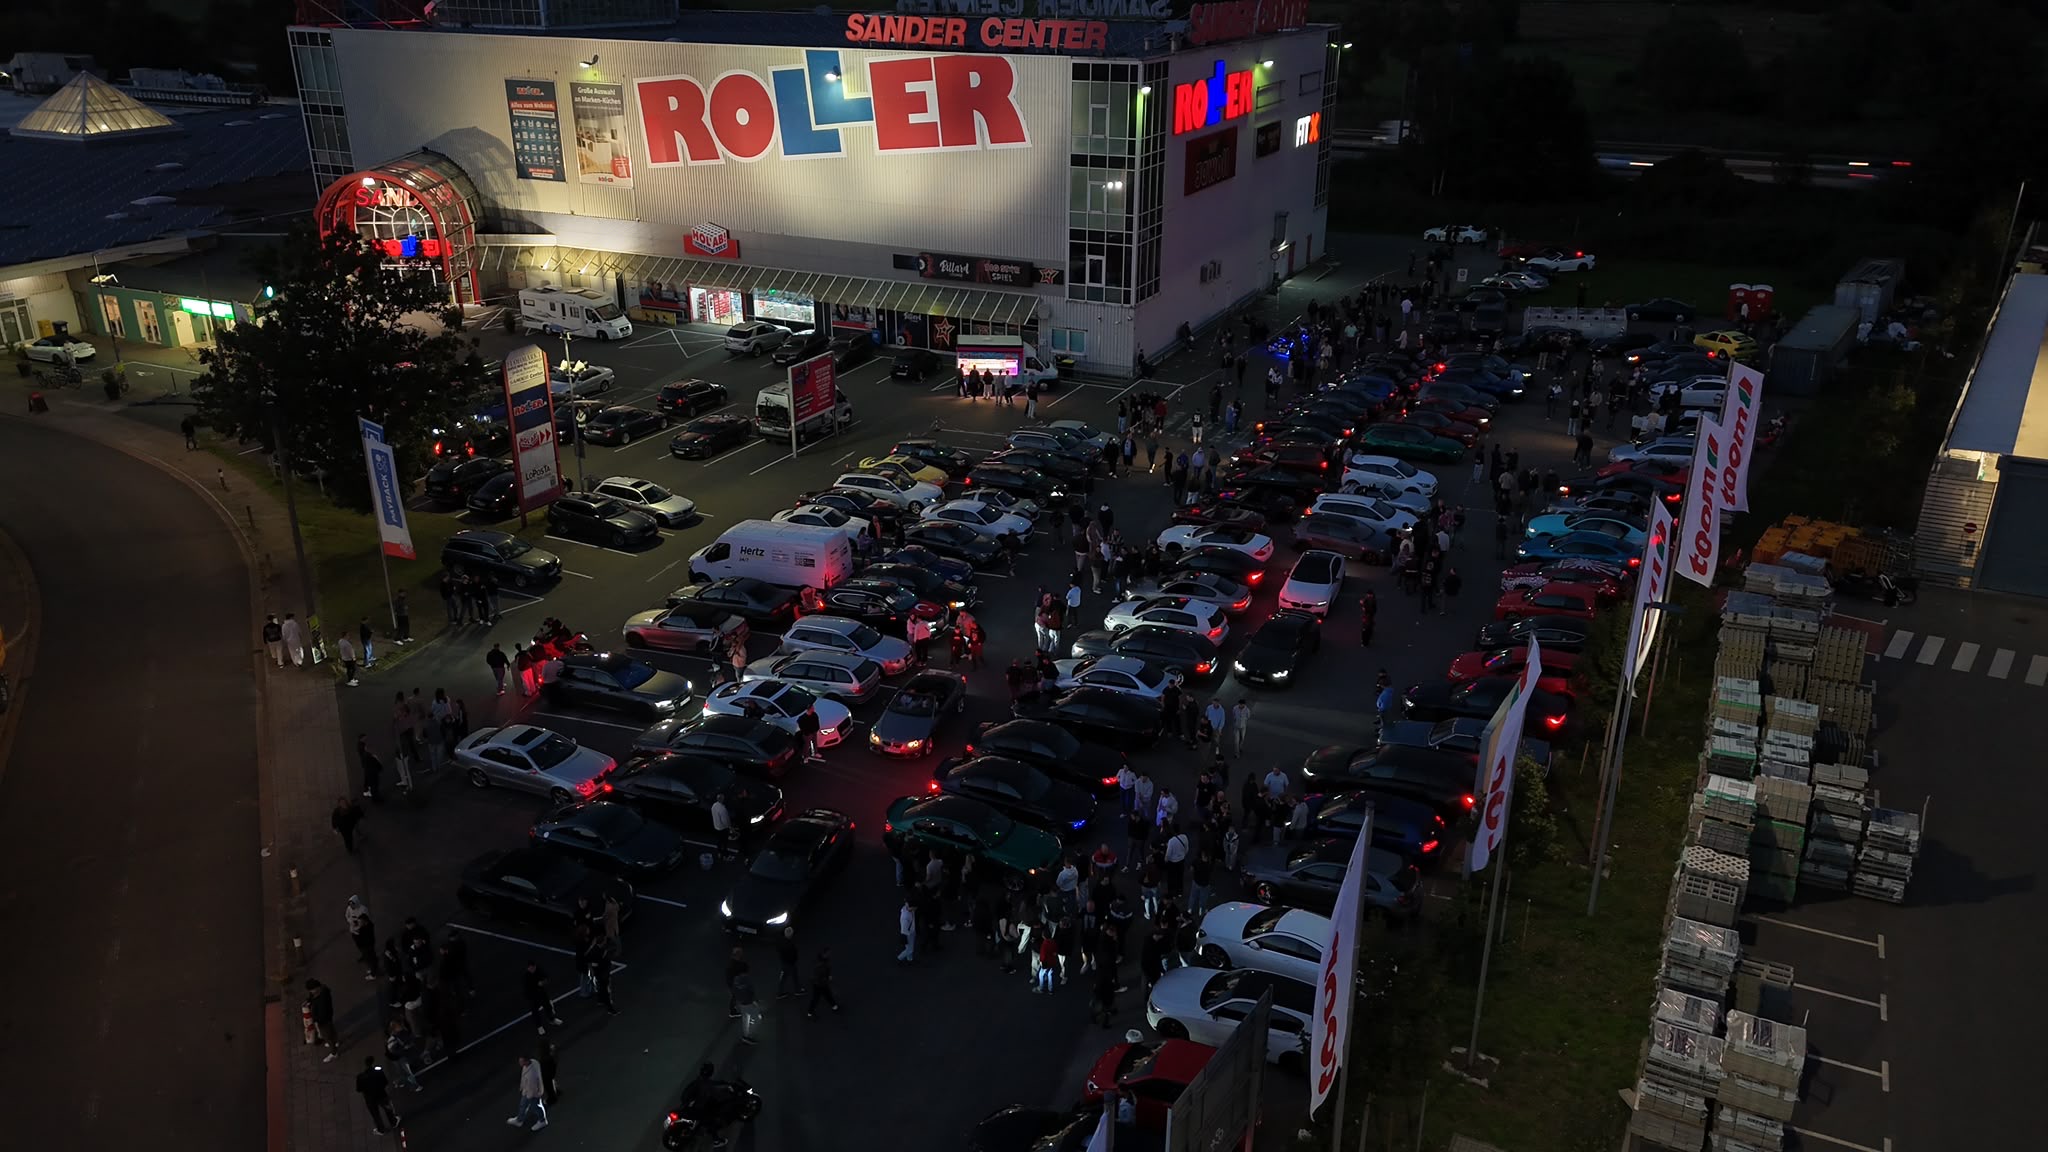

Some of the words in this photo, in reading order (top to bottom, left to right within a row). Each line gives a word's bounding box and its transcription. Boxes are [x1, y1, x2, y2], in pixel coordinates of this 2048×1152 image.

[846, 13, 967, 47] SANDER
[980, 18, 1109, 50] CENTER
[635, 48, 1032, 168] ROLLER
[1173, 59, 1254, 136] ROLLER
[939, 259, 970, 275] Billard
[991, 273, 1014, 283] SPIEL
[1720, 406, 1748, 508] toom
[381, 474, 398, 523] PAYBACK
[1688, 466, 1716, 577] toom
[740, 546, 765, 557] Hertz
